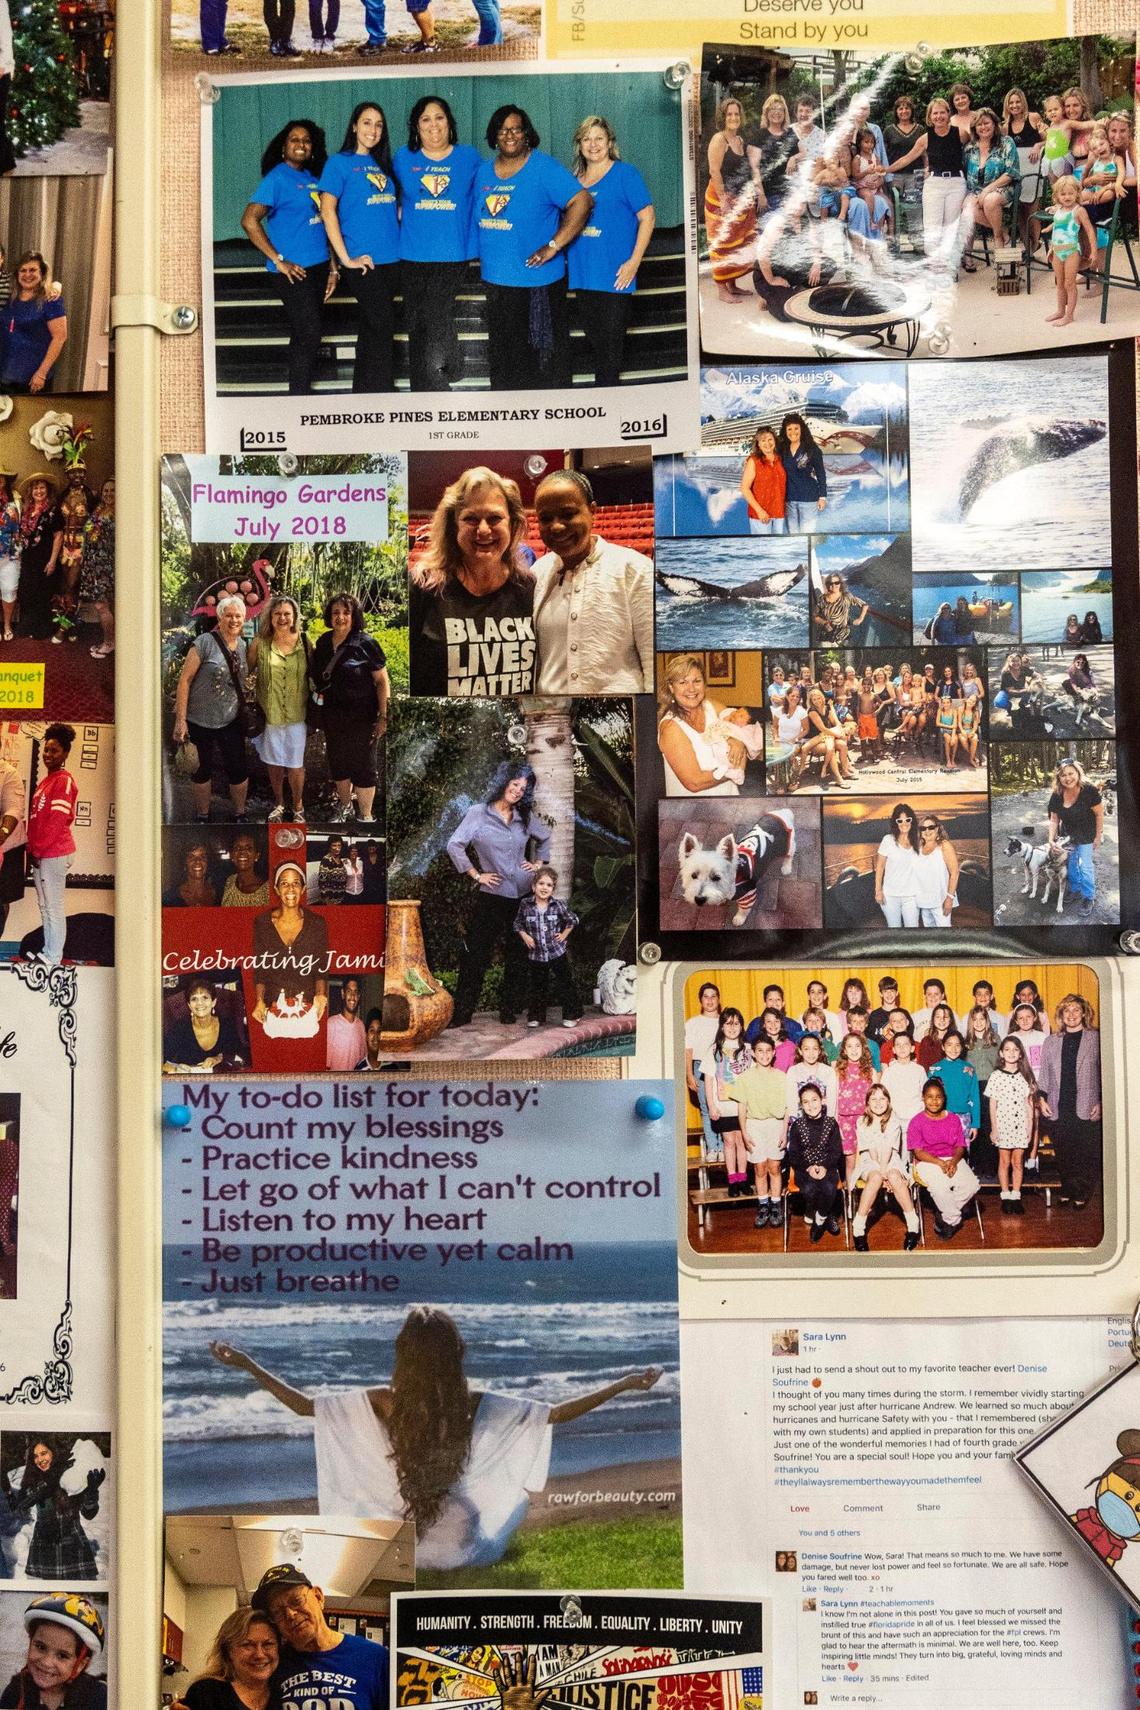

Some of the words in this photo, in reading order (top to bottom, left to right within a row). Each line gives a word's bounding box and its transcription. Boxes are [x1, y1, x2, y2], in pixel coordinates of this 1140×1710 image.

[744, 0, 822, 12] Deserve
[829, 0, 863, 15] you
[740, 22, 796, 39] Stand
[805, 22, 827, 42] by
[834, 24, 868, 42] you
[726, 372, 778, 384] Alaska
[784, 371, 833, 384] Cruise
[300, 412, 385, 426] PEMBROKE
[389, 411, 433, 423] PINES
[438, 409, 540, 422] ELEMENTARY
[545, 407, 607, 419] SCHOOL
[429, 431, 446, 439] 1ST
[448, 430, 480, 439] GRADE
[621, 420, 662, 433] 2016
[245, 432, 286, 444] 2015
[192, 483, 287, 508] Flamingo
[298, 483, 387, 503] Gardens
[234, 517, 281, 540] July
[292, 516, 347, 535] 2018
[444, 615, 534, 644] BLACK
[448, 641, 537, 678] LIVES
[448, 671, 532, 696] MATTER
[0, 690, 33, 703] 2018
[162, 950, 320, 977] Celebrating
[182, 1084, 228, 1114] My
[239, 1083, 323, 1108] to-do
[333, 1083, 374, 1108] list
[385, 1083, 428, 1108] for
[440, 1082, 539, 1111] today:
[201, 1115, 298, 1140] Count
[307, 1120, 355, 1144] my
[366, 1114, 504, 1144] blessings
[201, 1146, 331, 1171] Practice
[342, 1145, 478, 1170] kindness
[202, 1178, 250, 1201] Let
[259, 1182, 298, 1207] go
[308, 1176, 340, 1201] of
[349, 1176, 430, 1200] what
[439, 1176, 447, 1199] I
[457, 1174, 536, 1199] can't
[545, 1173, 661, 1198] control
[202, 1208, 293, 1232] Listen
[302, 1211, 336, 1231] to
[346, 1213, 394, 1236] my
[404, 1206, 487, 1230] heart
[202, 1239, 242, 1263] Be
[252, 1237, 428, 1267] productive
[438, 1239, 487, 1265] yet
[496, 1236, 574, 1261] calm
[200, 1270, 265, 1293] Just
[276, 1268, 400, 1292] breathe
[803, 1333, 823, 1341] Sara
[826, 1333, 846, 1343] Lynn
[772, 1365, 775, 1373] I
[776, 1365, 793, 1375] just
[795, 1365, 811, 1373] had
[813, 1365, 822, 1373] to
[824, 1365, 846, 1373] send
[855, 1365, 879, 1373] shout
[881, 1365, 895, 1373] out
[898, 1365, 907, 1373] to
[909, 1366, 922, 1375] my
[924, 1364, 956, 1372] favorite
[959, 1364, 991, 1372] teacher
[994, 1364, 1015, 1372] ever!
[1017, 1364, 1047, 1372] Denise
[772, 1378, 809, 1386] Soufrine
[772, 1390, 775, 1398] I
[777, 1390, 811, 1400] thought
[813, 1390, 822, 1398] of
[824, 1392, 840, 1400] you
[842, 1392, 865, 1400] many
[867, 1390, 891, 1398] times
[893, 1390, 921, 1400] during
[923, 1390, 937, 1398] the
[939, 1390, 967, 1398] storm.
[969, 1389, 972, 1397] I
[974, 1389, 1018, 1397] remember
[1021, 1389, 1048, 1399] vividly
[1050, 1389, 1085, 1399] starting
[773, 1405, 785, 1413] my
[788, 1403, 816, 1411] school
[819, 1404, 836, 1413] year
[840, 1402, 855, 1413] just
[857, 1402, 877, 1410] after
[879, 1402, 920, 1410] hurricane
[922, 1402, 957, 1410] Andrew.
[960, 1402, 973, 1410] We
[975, 1401, 1008, 1409] learned
[1023, 1401, 1047, 1409] much
[547, 1489, 677, 1506] rawforbeauty.com
[802, 1552, 828, 1560] Denise
[864, 1552, 884, 1561] Wow,
[886, 1551, 904, 1559] Sara!
[907, 1551, 923, 1559] That
[984, 1550, 992, 1558] to
[840, 1599, 858, 1608] Lynn
[416, 1616, 471, 1631] HUMANITY
[480, 1616, 534, 1629] STRENGTH
[543, 1616, 592, 1629] FREEOM
[601, 1616, 650, 1631] EQUALITY
[660, 1618, 702, 1632] LIBERTY
[712, 1621, 743, 1634] UNITY
[281, 1671, 309, 1692] THE
[311, 1670, 357, 1688] BEST
[294, 1688, 318, 1696] KIND
[321, 1686, 334, 1695] OF
